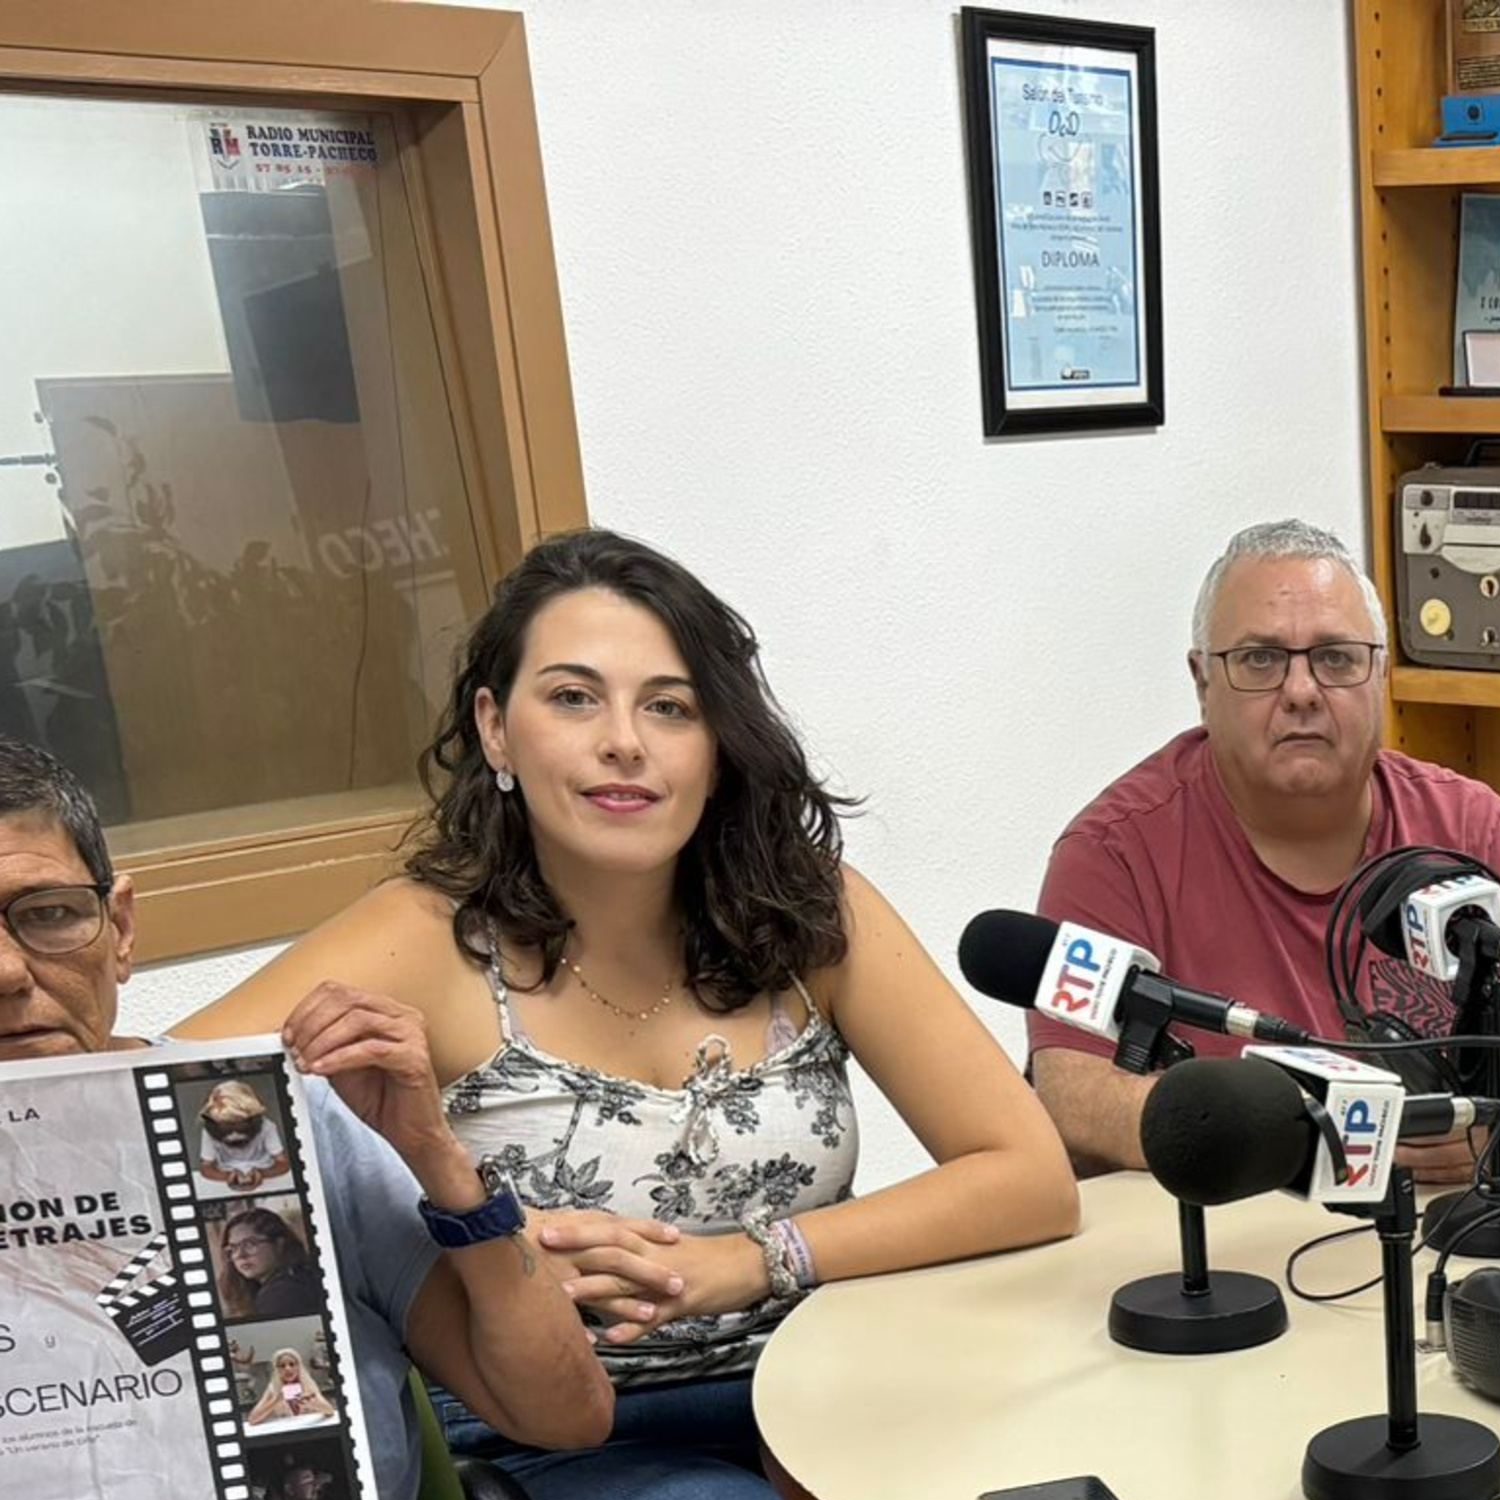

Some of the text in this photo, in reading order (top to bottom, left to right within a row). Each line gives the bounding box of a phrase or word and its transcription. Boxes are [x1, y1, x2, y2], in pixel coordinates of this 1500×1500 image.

[246, 124, 375, 146] RADIO MUNICIPAL
[249, 142, 378, 162] TORRE-PACHECO
[1041, 251, 1100, 268] DIPLOMA
[1051, 938, 1100, 1012] RTP
[8, 1108, 40, 1123] LA
[74, 1191, 120, 1215] DE
[0, 1368, 182, 1418] CENARIO
